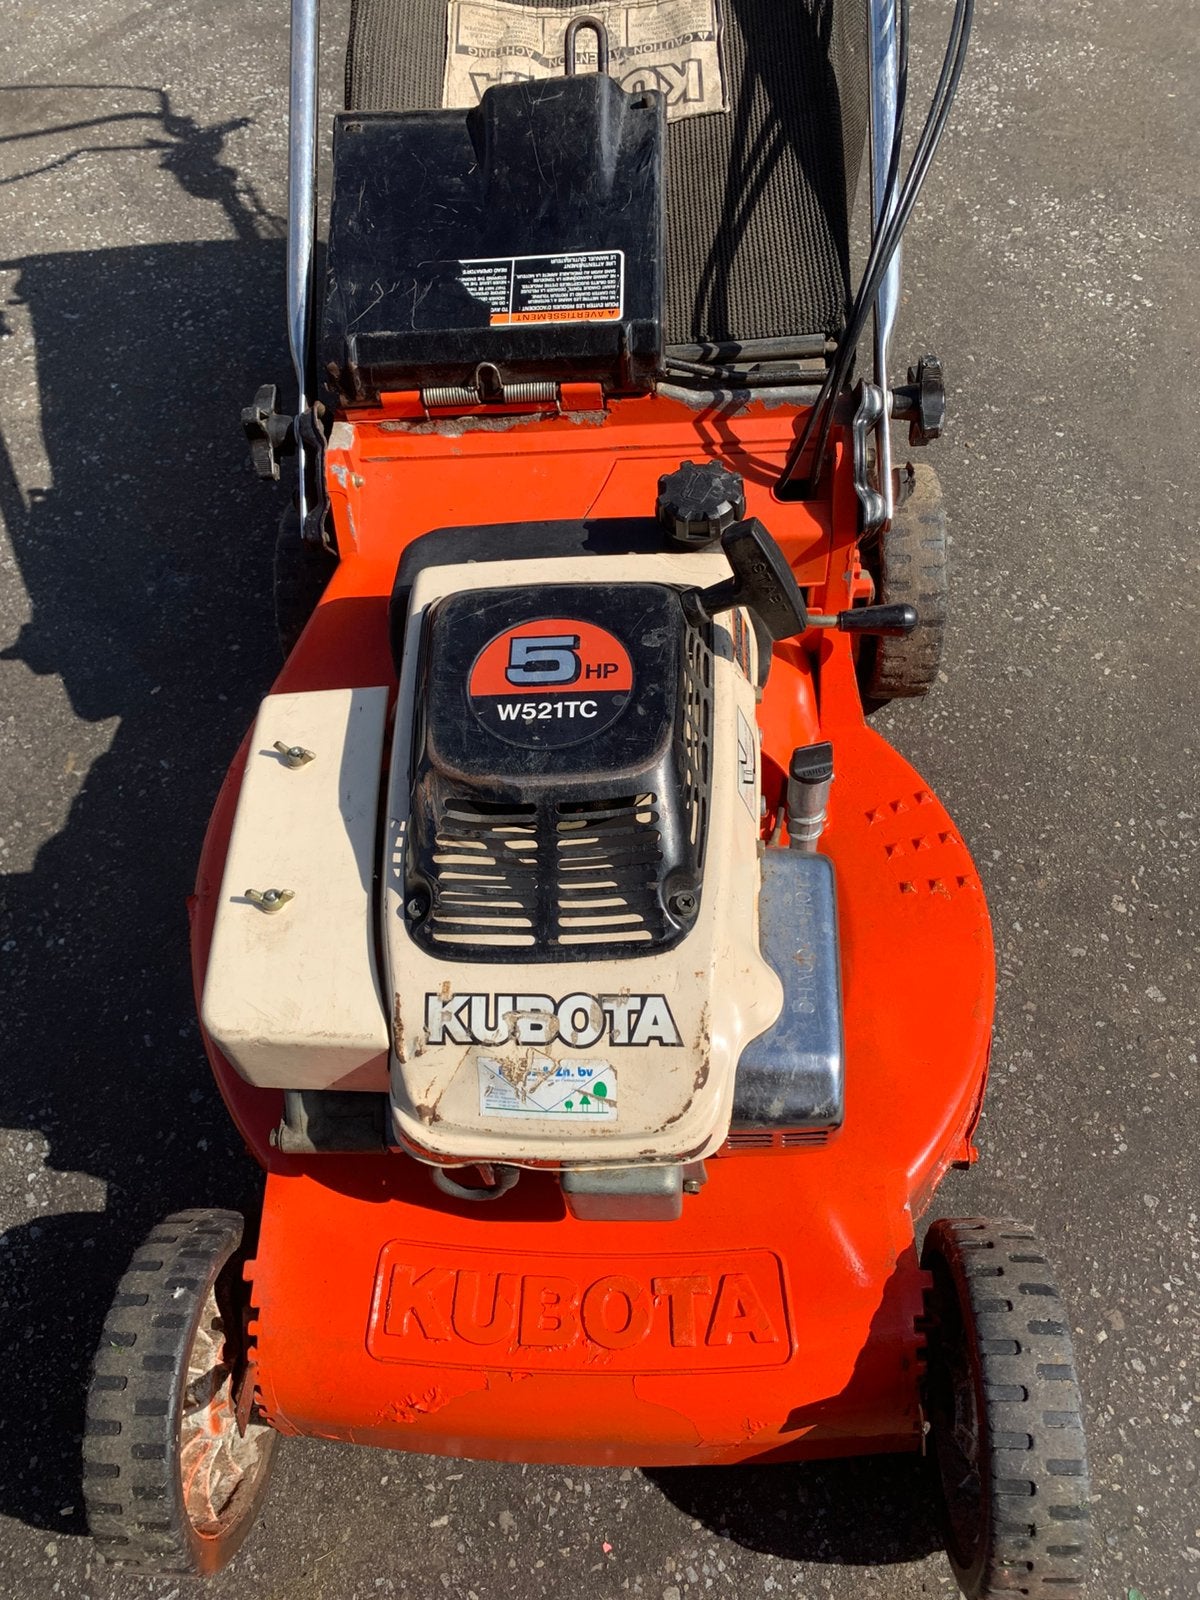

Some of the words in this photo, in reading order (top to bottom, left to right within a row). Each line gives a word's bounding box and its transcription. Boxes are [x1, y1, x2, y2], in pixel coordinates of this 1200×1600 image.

[467, 46, 535, 58] ACHTUNG
[633, 33, 694, 54] CAUTION
[517, 311, 604, 322] AVERTISSEMENT
[505, 634, 582, 687] 5
[585, 663, 619, 680] HP
[497, 700, 598, 721] W521TC
[424, 992, 685, 1050] KUBOTA
[578, 1066, 594, 1077] bv
[382, 1263, 780, 1350] KUBOTA
